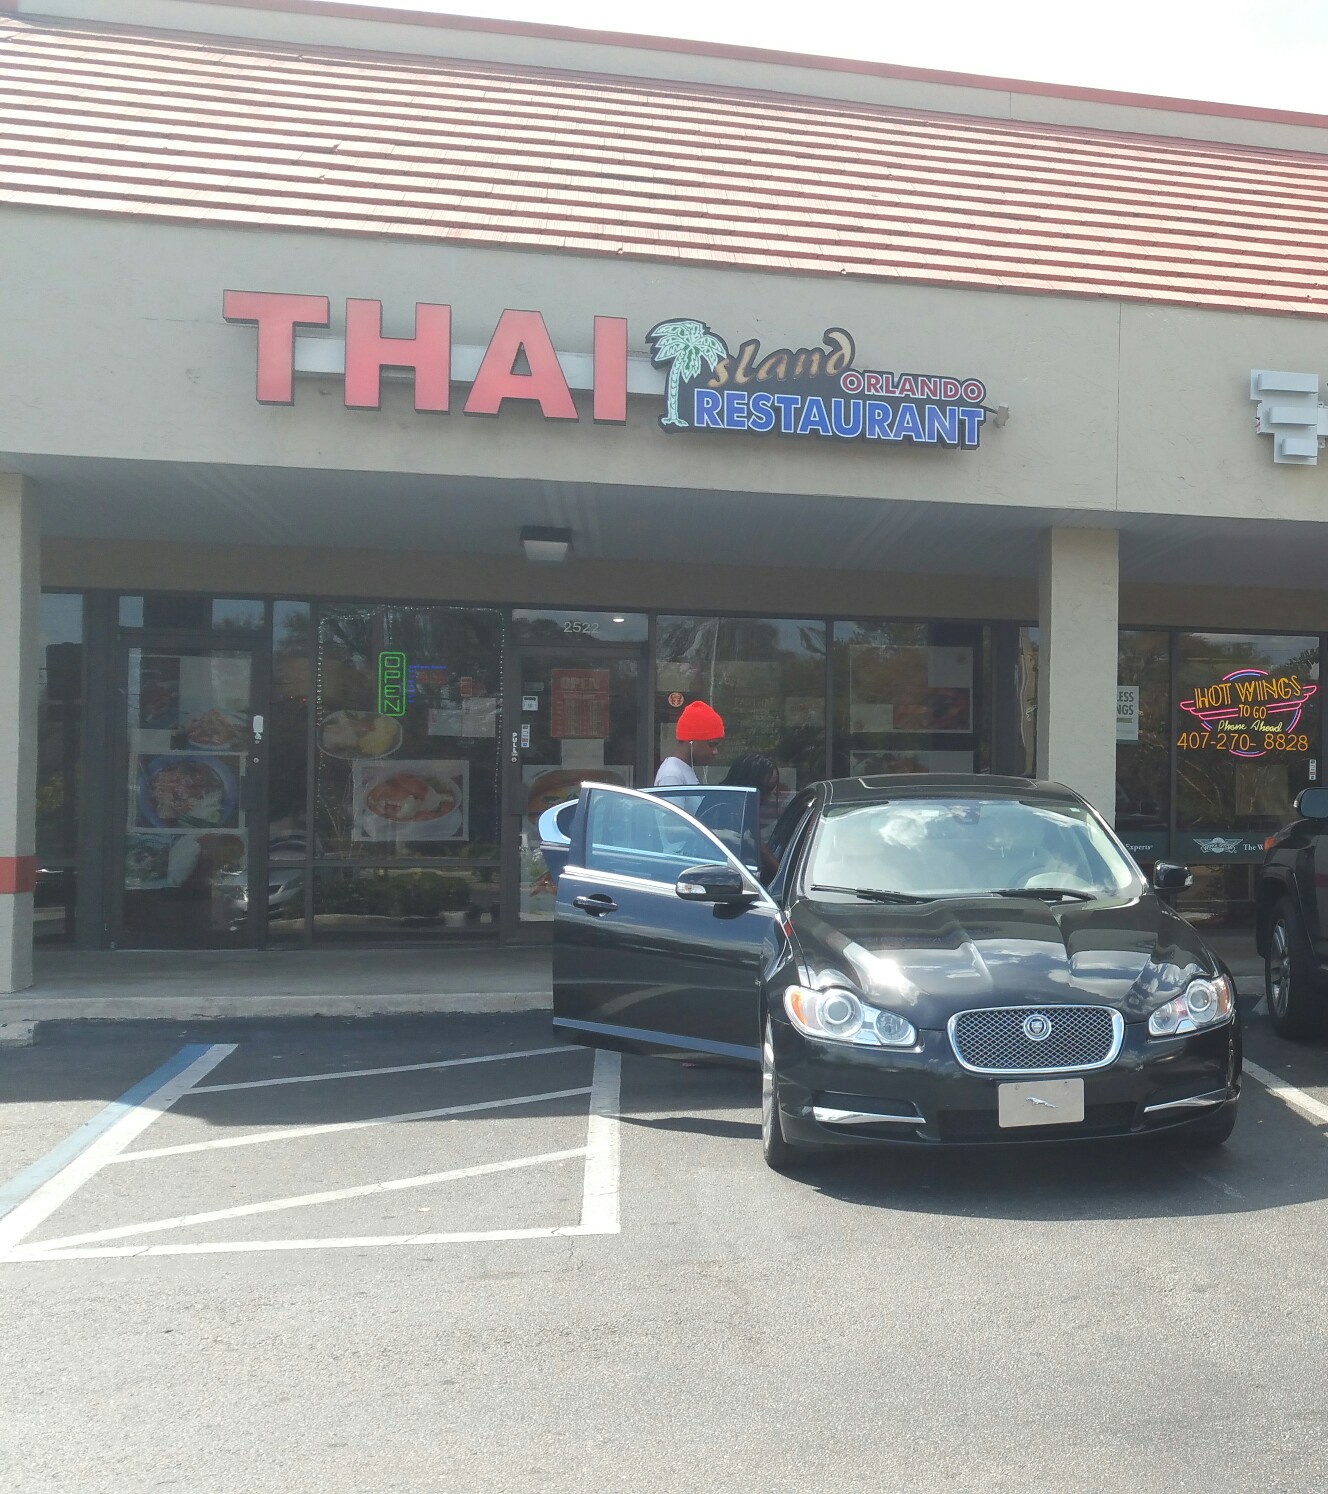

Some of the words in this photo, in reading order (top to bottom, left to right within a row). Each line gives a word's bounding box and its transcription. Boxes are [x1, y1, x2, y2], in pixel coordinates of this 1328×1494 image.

[223, 289, 627, 426] THAI
[840, 371, 985, 403] ORLANDO
[693, 388, 985, 446] RESTAURANT
[563, 621, 600, 634] 2522
[384, 656, 401, 713] OPEN
[558, 676, 601, 690] OPEN
[1194, 683, 1232, 709] HOT
[1235, 675, 1302, 703] WINGS
[1217, 719, 1248, 732] Phone
[1249, 719, 1283, 733] Ahead
[1238, 704, 1250, 718] TO
[1252, 705, 1267, 719] GO
